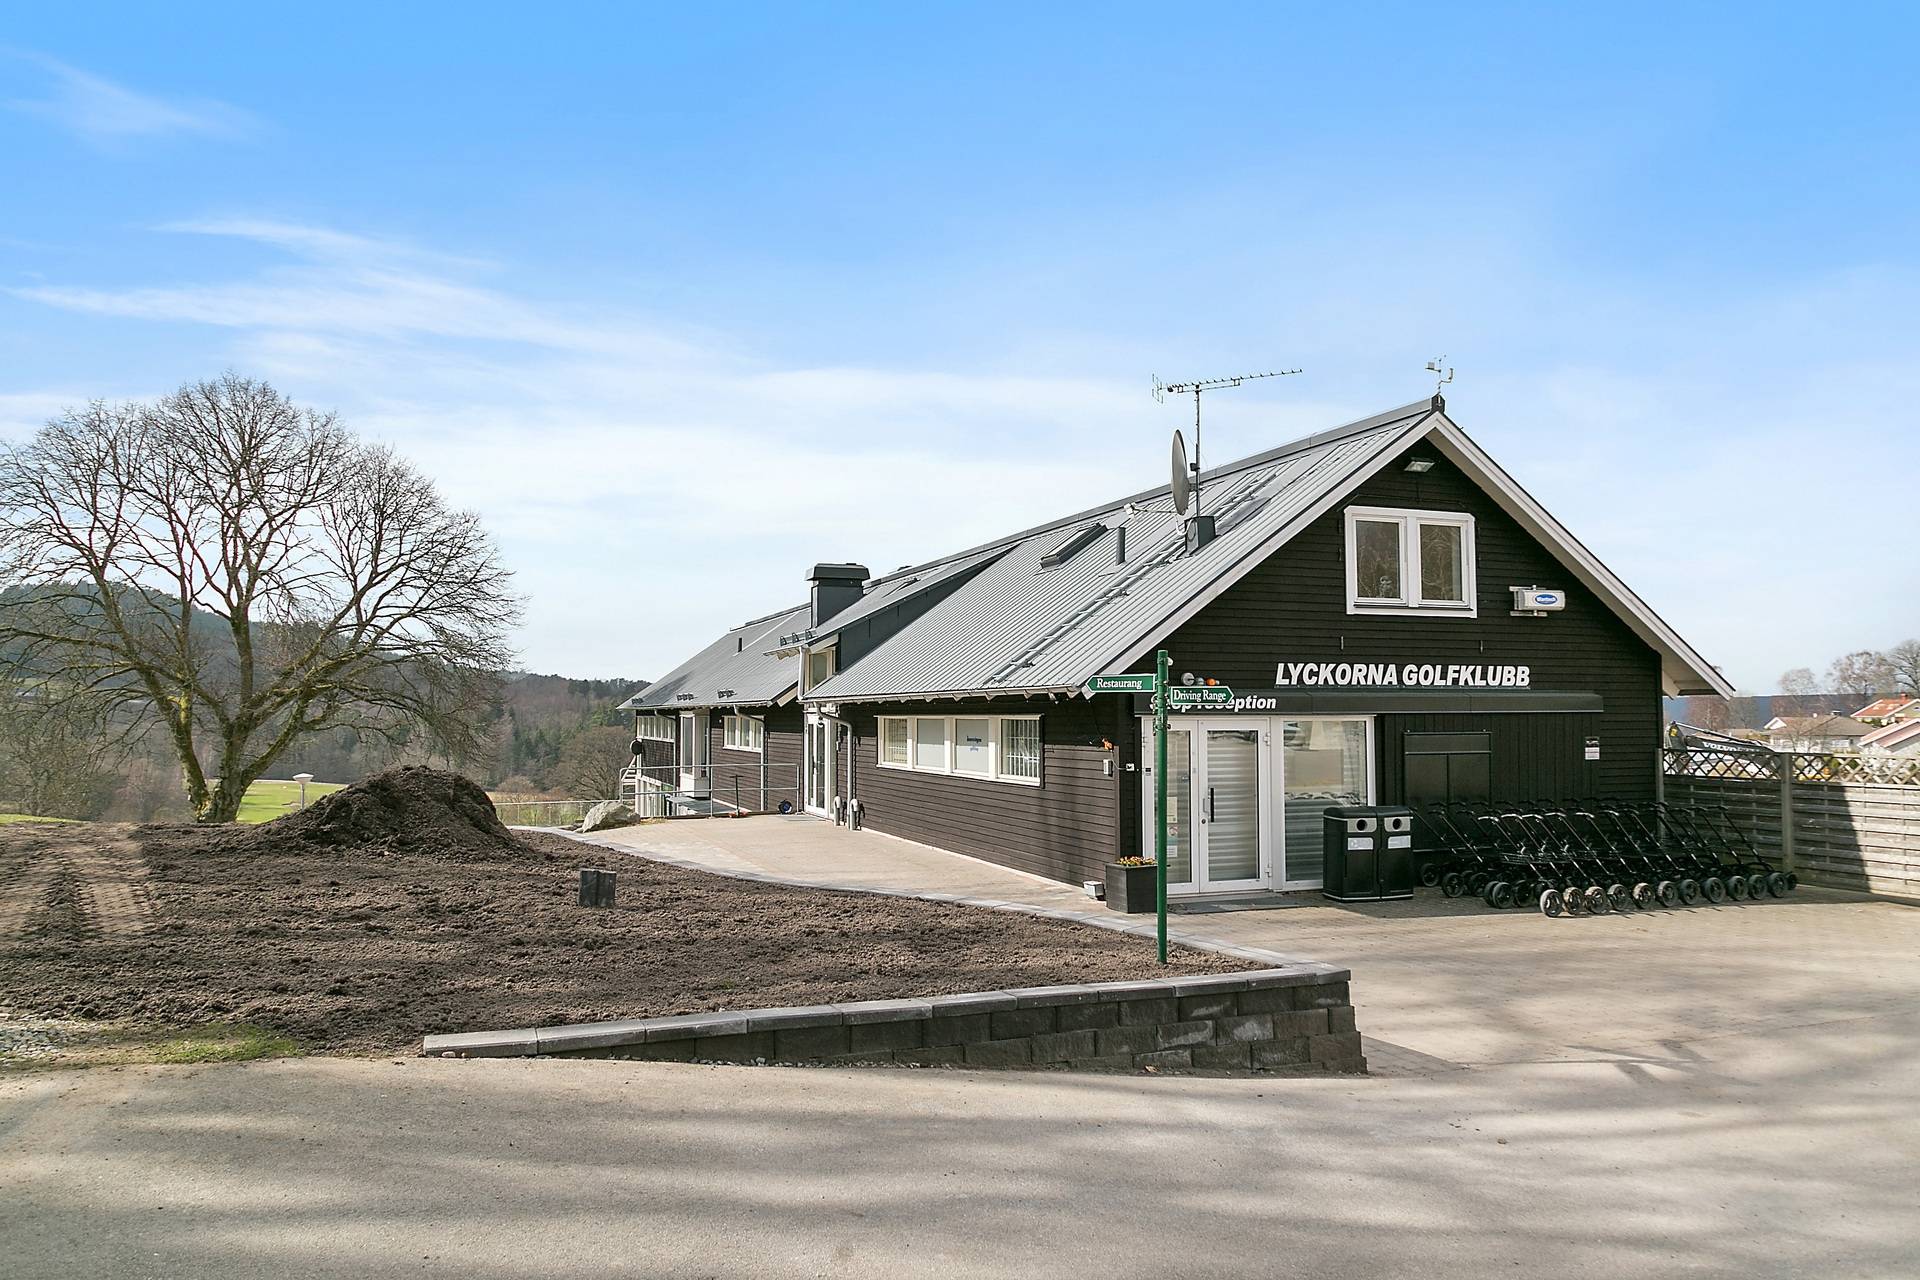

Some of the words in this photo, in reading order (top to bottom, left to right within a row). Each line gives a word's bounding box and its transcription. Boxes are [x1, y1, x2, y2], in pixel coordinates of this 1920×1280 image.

[1275, 663, 1397, 686] LYCKORNA
[1402, 664, 1530, 687] GOLFKLUBB
[1096, 677, 1143, 690] Restaurang
[1173, 689, 1201, 703] Driving
[1202, 689, 1227, 702] Range
